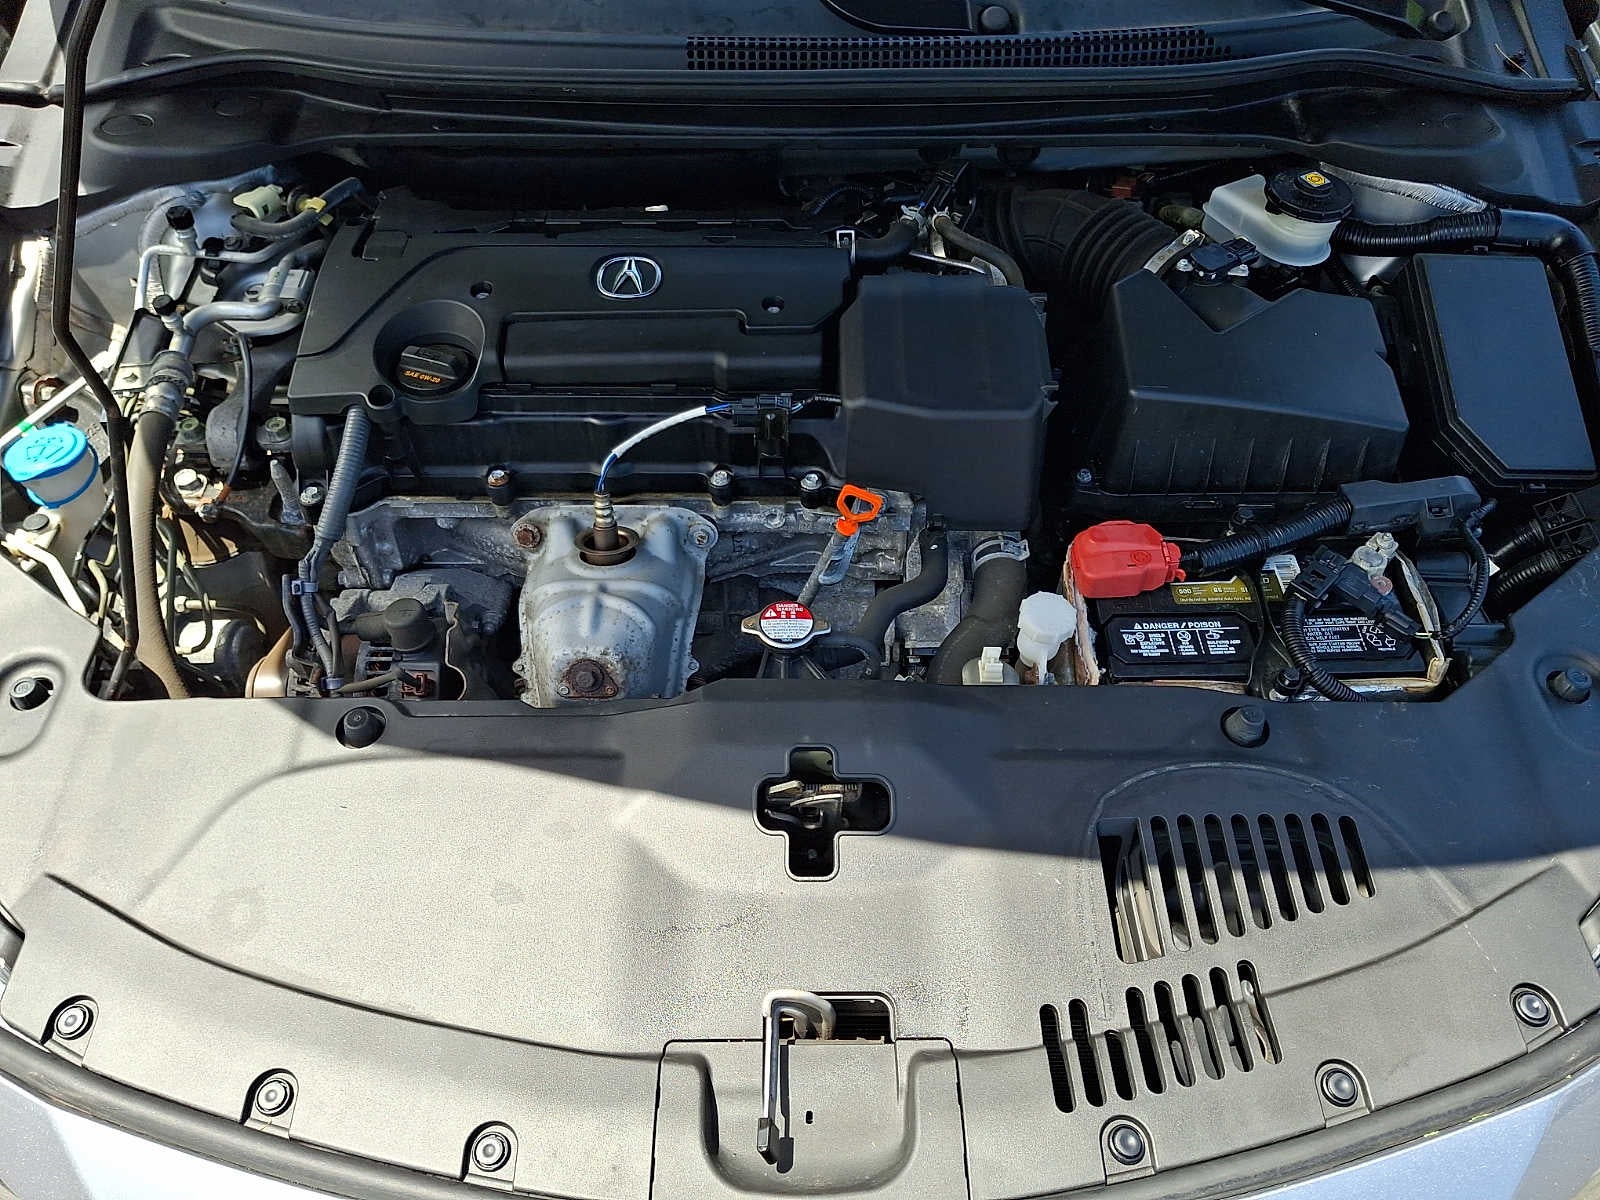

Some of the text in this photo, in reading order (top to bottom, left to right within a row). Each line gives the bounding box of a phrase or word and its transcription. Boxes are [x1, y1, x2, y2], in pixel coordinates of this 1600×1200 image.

[404, 370, 441, 383] SAE 0W-20
[1142, 621, 1180, 629] DANGER
